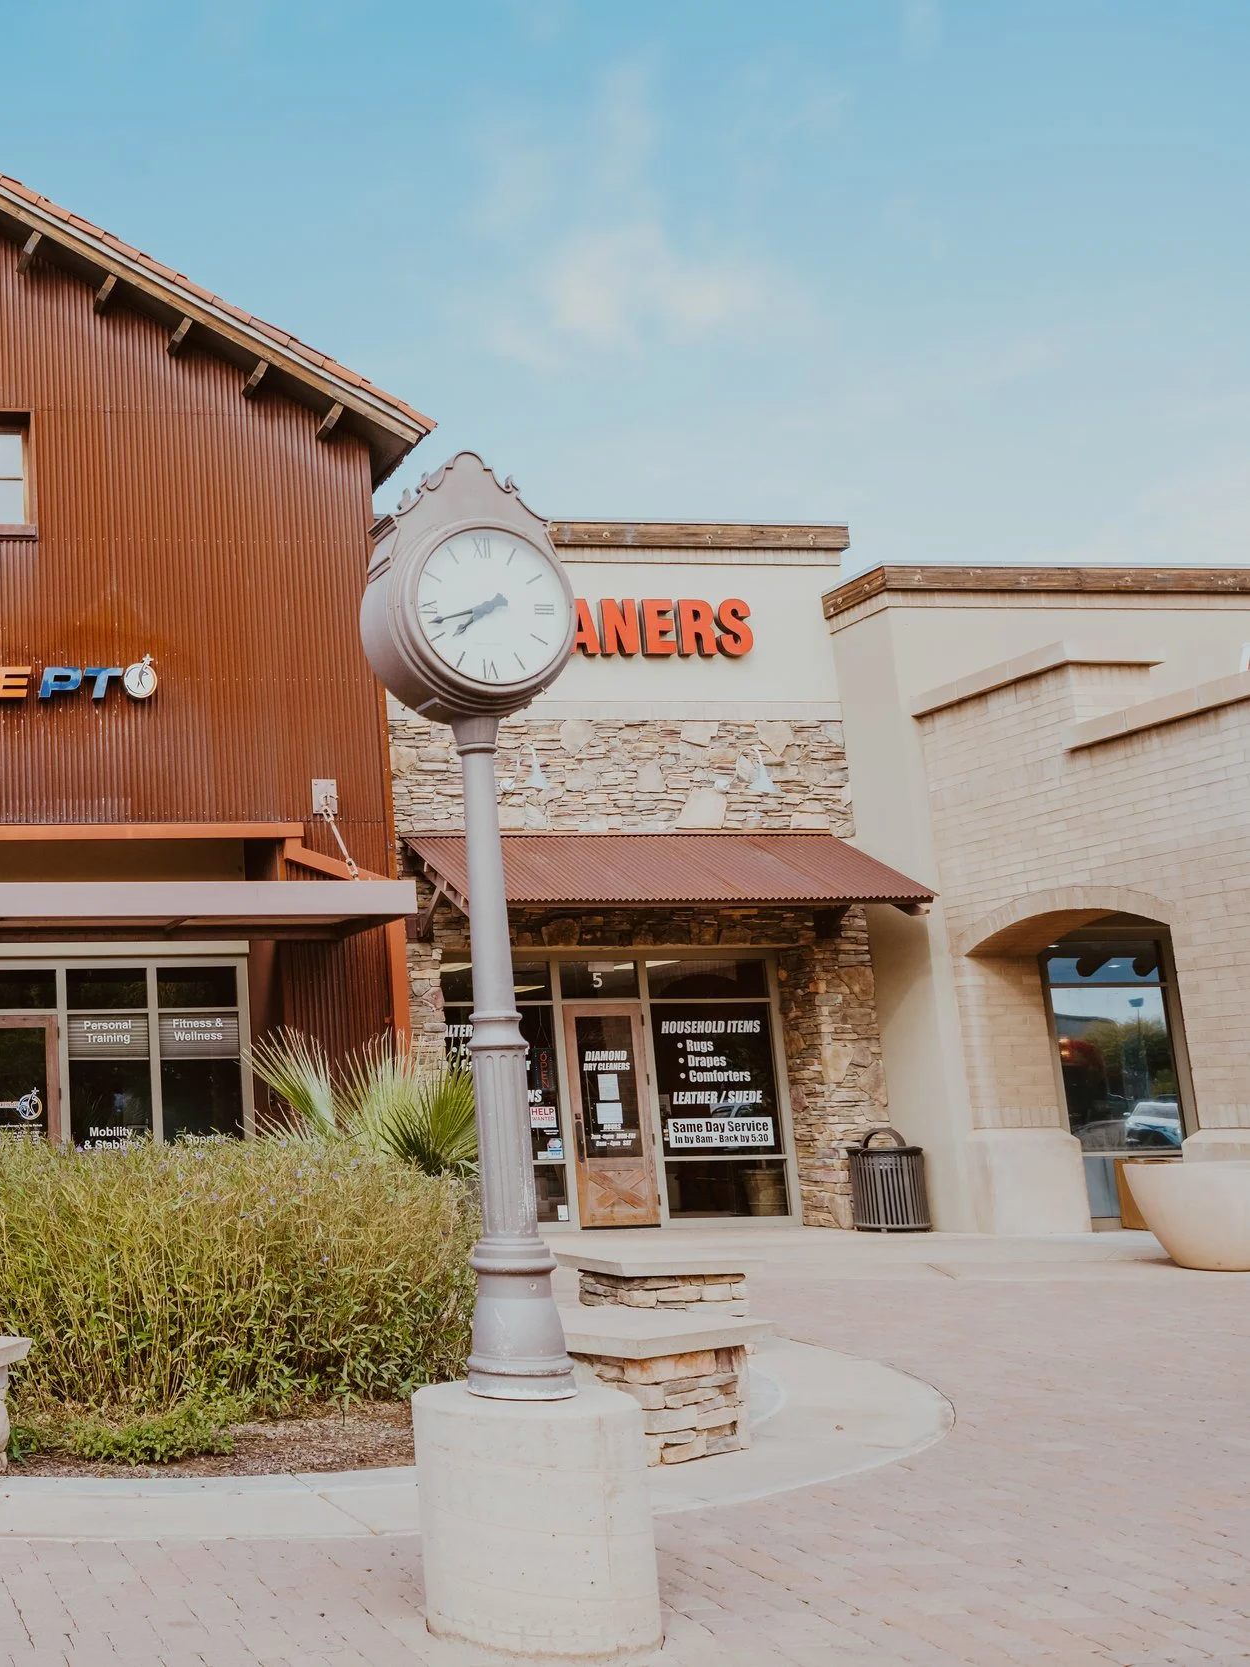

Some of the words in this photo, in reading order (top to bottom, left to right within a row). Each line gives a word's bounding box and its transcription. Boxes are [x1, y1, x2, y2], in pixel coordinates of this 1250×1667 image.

[572, 598, 754, 656] ANERS
[38, 666, 125, 700] PT
[593, 973, 603, 988] 5
[83, 1019, 132, 1031] Personal
[172, 1017, 212, 1029] Fitness
[215, 1017, 223, 1028] &
[661, 1020, 725, 1034] HOUSEHOLD
[727, 1020, 760, 1033] ITEMS
[174, 1030, 223, 1042] Wellness
[445, 1024, 474, 1037] ALTER
[86, 1032, 131, 1044] Training
[686, 1039, 714, 1053] Rugs
[584, 1050, 628, 1062] DIAMOND
[687, 1054, 727, 1068] Drapes
[539, 1052, 551, 1089] OPEN
[583, 1062, 597, 1071] DRY
[597, 1061, 630, 1071] CLEANERS
[689, 1069, 751, 1082] Comforters
[528, 1089, 543, 1103] NS
[673, 1091, 718, 1105] LEATHER
[727, 1090, 763, 1104] SUEDE
[531, 1107, 555, 1116] HELP
[89, 1126, 133, 1138] Mobility
[672, 1121, 703, 1133] Same
[706, 1121, 725, 1133] Day
[728, 1120, 769, 1132] Service
[83, 1140, 92, 1150] &
[675, 1135, 684, 1144] In
[685, 1135, 694, 1144] by
[695, 1135, 713, 1143] 8am
[719, 1134, 739, 1143] Back
[740, 1134, 750, 1143] by
[751, 1133, 769, 1142] 5:30
